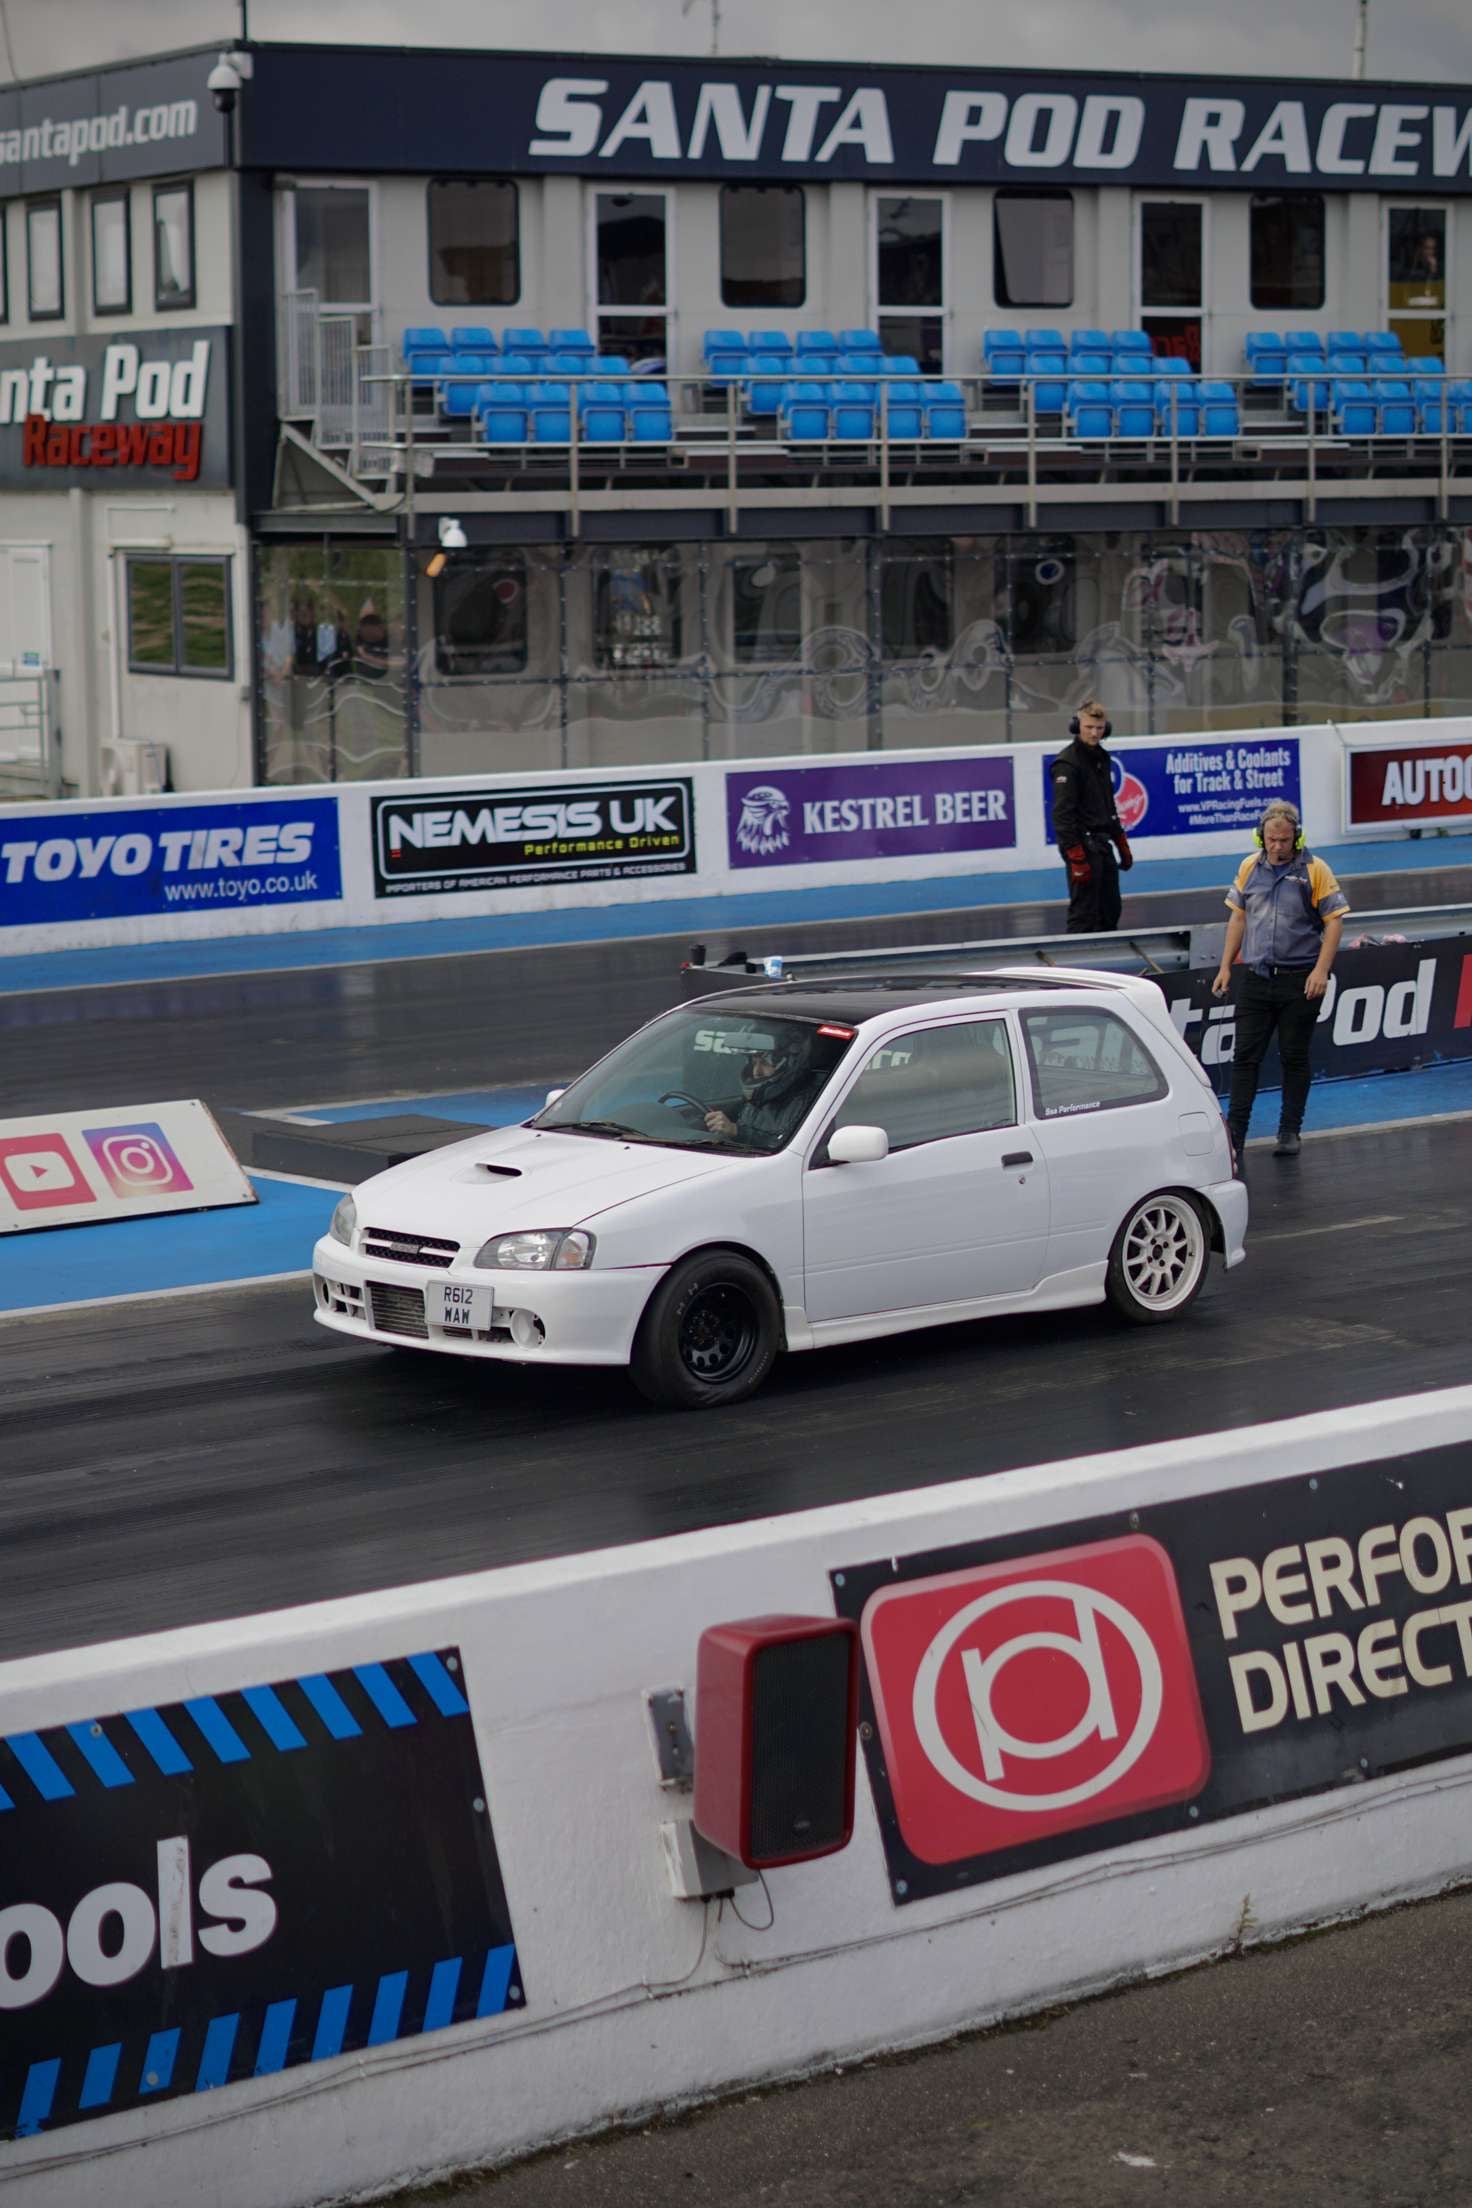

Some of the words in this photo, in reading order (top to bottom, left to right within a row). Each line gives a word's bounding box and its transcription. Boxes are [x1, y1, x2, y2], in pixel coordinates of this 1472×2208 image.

[528, 77, 895, 163] SANTA
[932, 90, 1145, 169] POD
[101, 340, 210, 420] Pod
[24, 414, 204, 480] Raceway
[1166, 751, 1223, 774] Additives
[1225, 749, 1235, 770] &
[1237, 747, 1290, 769] Coolants
[1174, 774, 1193, 794] for
[1195, 770, 1231, 793] Track
[1233, 769, 1243, 790] &
[1245, 767, 1284, 789] Street
[388, 801, 603, 850] NEMESIS
[609, 796, 679, 834] UK
[803, 795, 929, 834] KESTREL
[935, 789, 1008, 825] BEER
[2, 834, 153, 884] TOYO
[159, 822, 315, 872] TIRES
[524, 837, 623, 856] Performance
[629, 834, 680, 848] Driven
[164, 870, 318, 901] www.toyo.co.uk
[443, 1286, 473, 1305] R612
[444, 1306, 470, 1325] WAW
[1228, 1600, 1472, 1734] DIRECT
